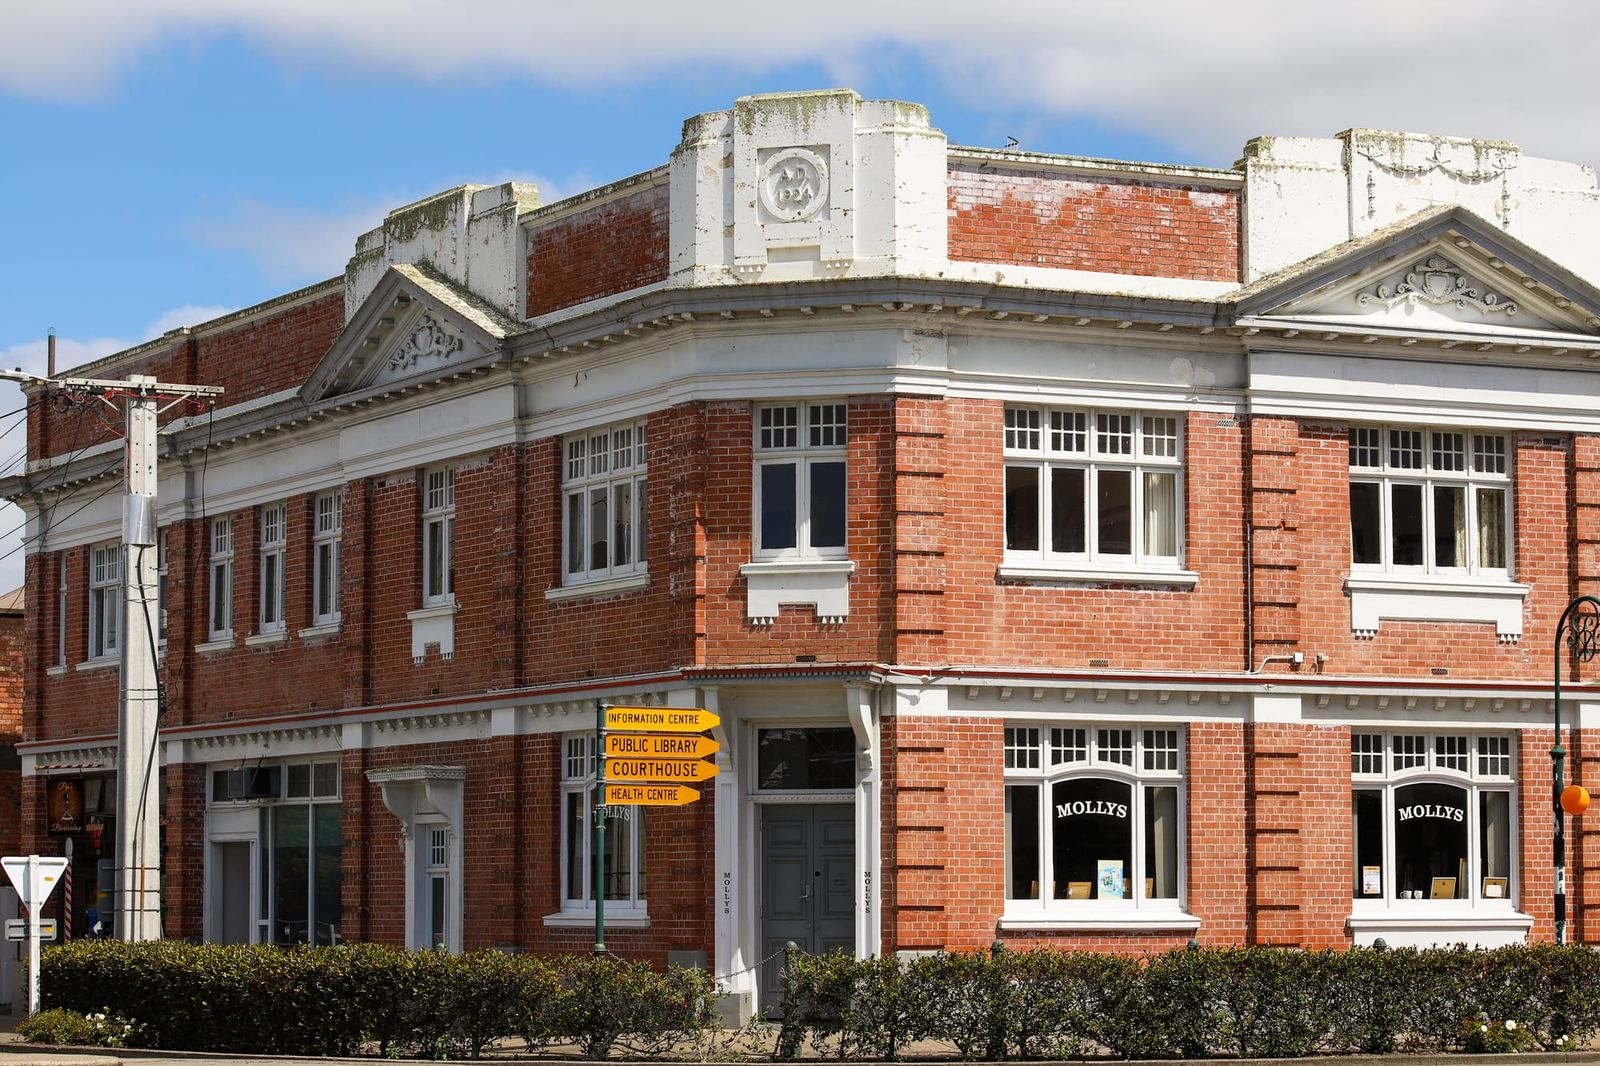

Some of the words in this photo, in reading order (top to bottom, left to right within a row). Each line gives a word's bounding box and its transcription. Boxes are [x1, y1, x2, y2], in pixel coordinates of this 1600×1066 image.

[608, 713, 664, 724] INFORMATION
[668, 714, 700, 725] CENTRE
[611, 738, 649, 752] PUBLIC
[654, 739, 698, 753] LIBRARY
[612, 762, 698, 777] COURTHOUSE
[611, 788, 643, 800] HEALTH
[647, 789, 678, 801] CENTRE
[1056, 801, 1128, 819] MOLLYS
[1398, 804, 1465, 822] MOLLYS
[723, 872, 731, 914] MOLLYS
[864, 871, 872, 914] MOLLYS
